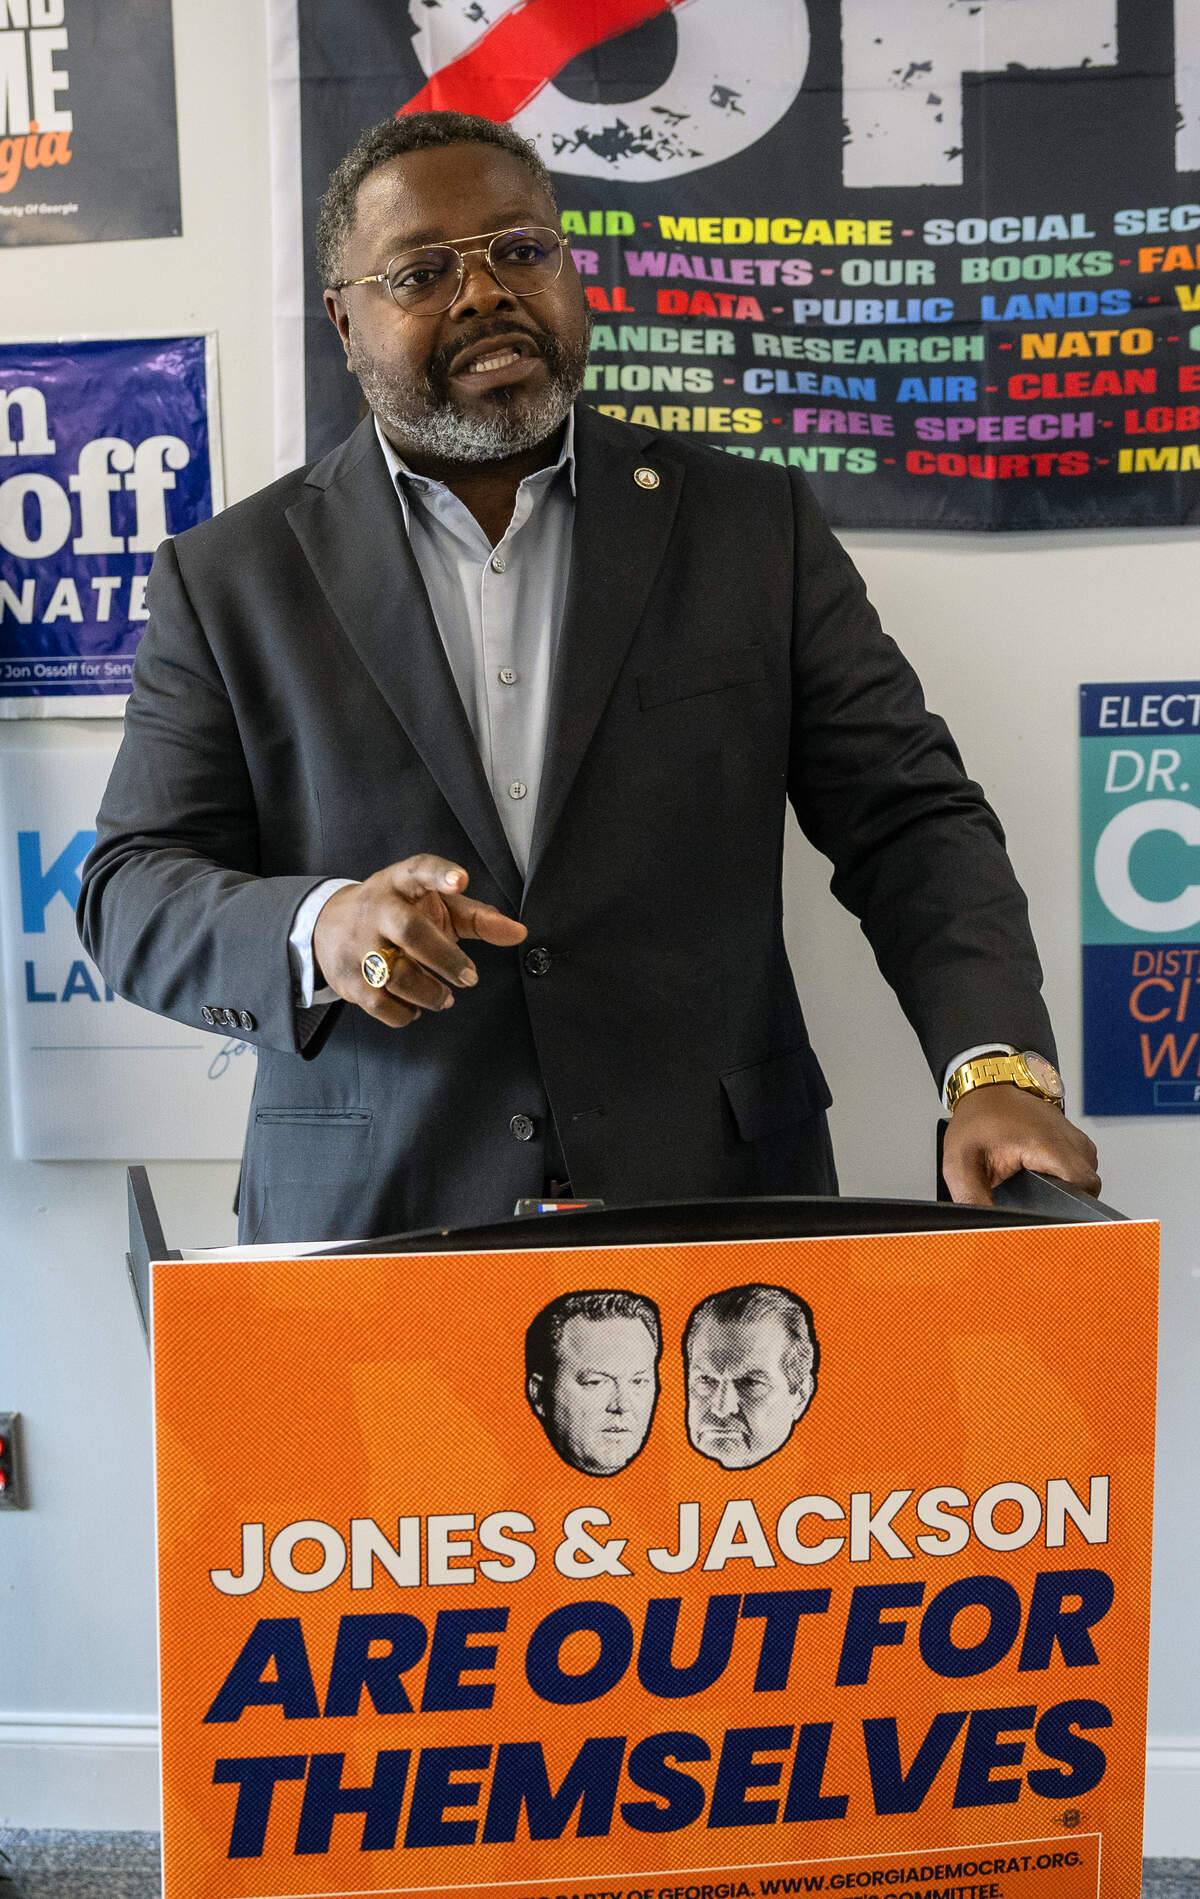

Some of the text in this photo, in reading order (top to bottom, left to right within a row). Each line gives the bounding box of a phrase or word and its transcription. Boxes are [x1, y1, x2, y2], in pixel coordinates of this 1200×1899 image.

[561, 204, 1200, 246] AID MEDICARE SOCIAL SEC
[624, 250, 814, 286] WALLETS
[841, 259, 936, 287] OUR
[961, 250, 1114, 284] BOOKS
[1138, 243, 1200, 274] FA
[657, 289, 765, 323] DATA
[792, 297, 954, 325] PUBLIC
[981, 289, 1132, 322] LANDS
[590, 325, 736, 356] ANCER
[752, 332, 985, 364] RESEARCH
[1020, 327, 1154, 360] NATO
[743, 368, 877, 403] CLEAN
[896, 376, 978, 403] AIR
[1008, 368, 1157, 400] CLEAN
[792, 407, 895, 436] FREE
[915, 412, 1095, 443] SPEECH
[905, 450, 1090, 479] COURTS
[5, 664, 31, 678] Jon
[34, 662, 78, 677] Ossoff
[80, 662, 101, 676] for
[1099, 694, 1200, 728] ELECT
[1104, 748, 1190, 793] DR.
[25, 960, 115, 1002] LA
[1132, 950, 1200, 977] DIST
[1129, 977, 1200, 1024] CI
[209, 1475, 1110, 1596] JONES & JACKSON
[203, 1568, 1115, 1723] ARE OUT FOR
[211, 1698, 1113, 1859] THEMSELVES
[658, 1882, 755, 1899] GEORGIA.
[760, 1851, 1084, 1895] WWW.GEORGIADEMOCRAT.ORG.
